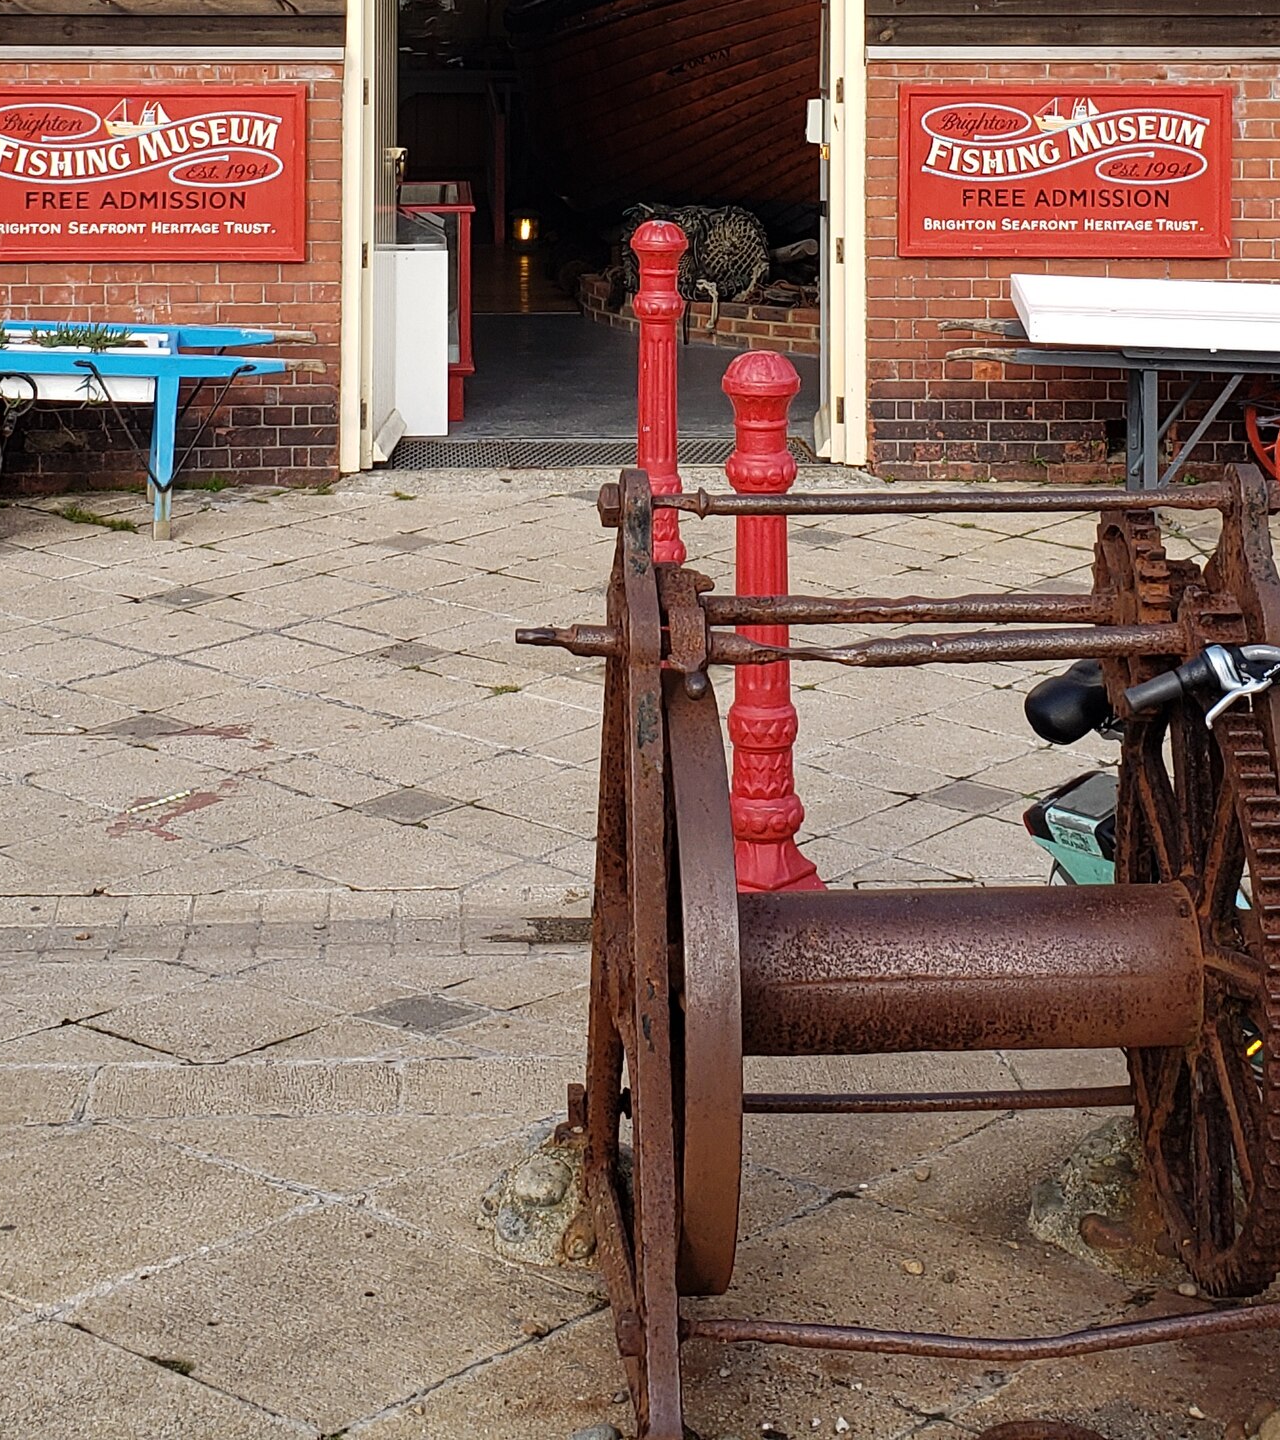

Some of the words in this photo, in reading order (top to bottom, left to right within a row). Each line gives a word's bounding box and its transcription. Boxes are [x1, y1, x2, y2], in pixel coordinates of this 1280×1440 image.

[2, 111, 83, 136] Brighton
[941, 111, 1020, 136] Brighton
[137, 117, 279, 165] MUSEUM
[926, 136, 1061, 176] FISHING
[1067, 114, 1207, 158] MUSEUM
[185, 164, 219, 179] Est.
[1108, 162, 1140, 177] Est.
[25, 190, 89, 210] FREE
[100, 190, 246, 210] ADMISSION
[962, 188, 1026, 208] FREE
[1034, 188, 1170, 208] ADMISSION
[67, 220, 147, 235] SEAFRONT
[150, 220, 220, 235] HERITAGE
[223, 220, 277, 235] TRUST.
[923, 216, 996, 231] BRIGHTON
[1001, 216, 1078, 232] SEAFRONT
[1083, 217, 1153, 232] HERITAGE
[1155, 217, 1205, 233] TRUST.
